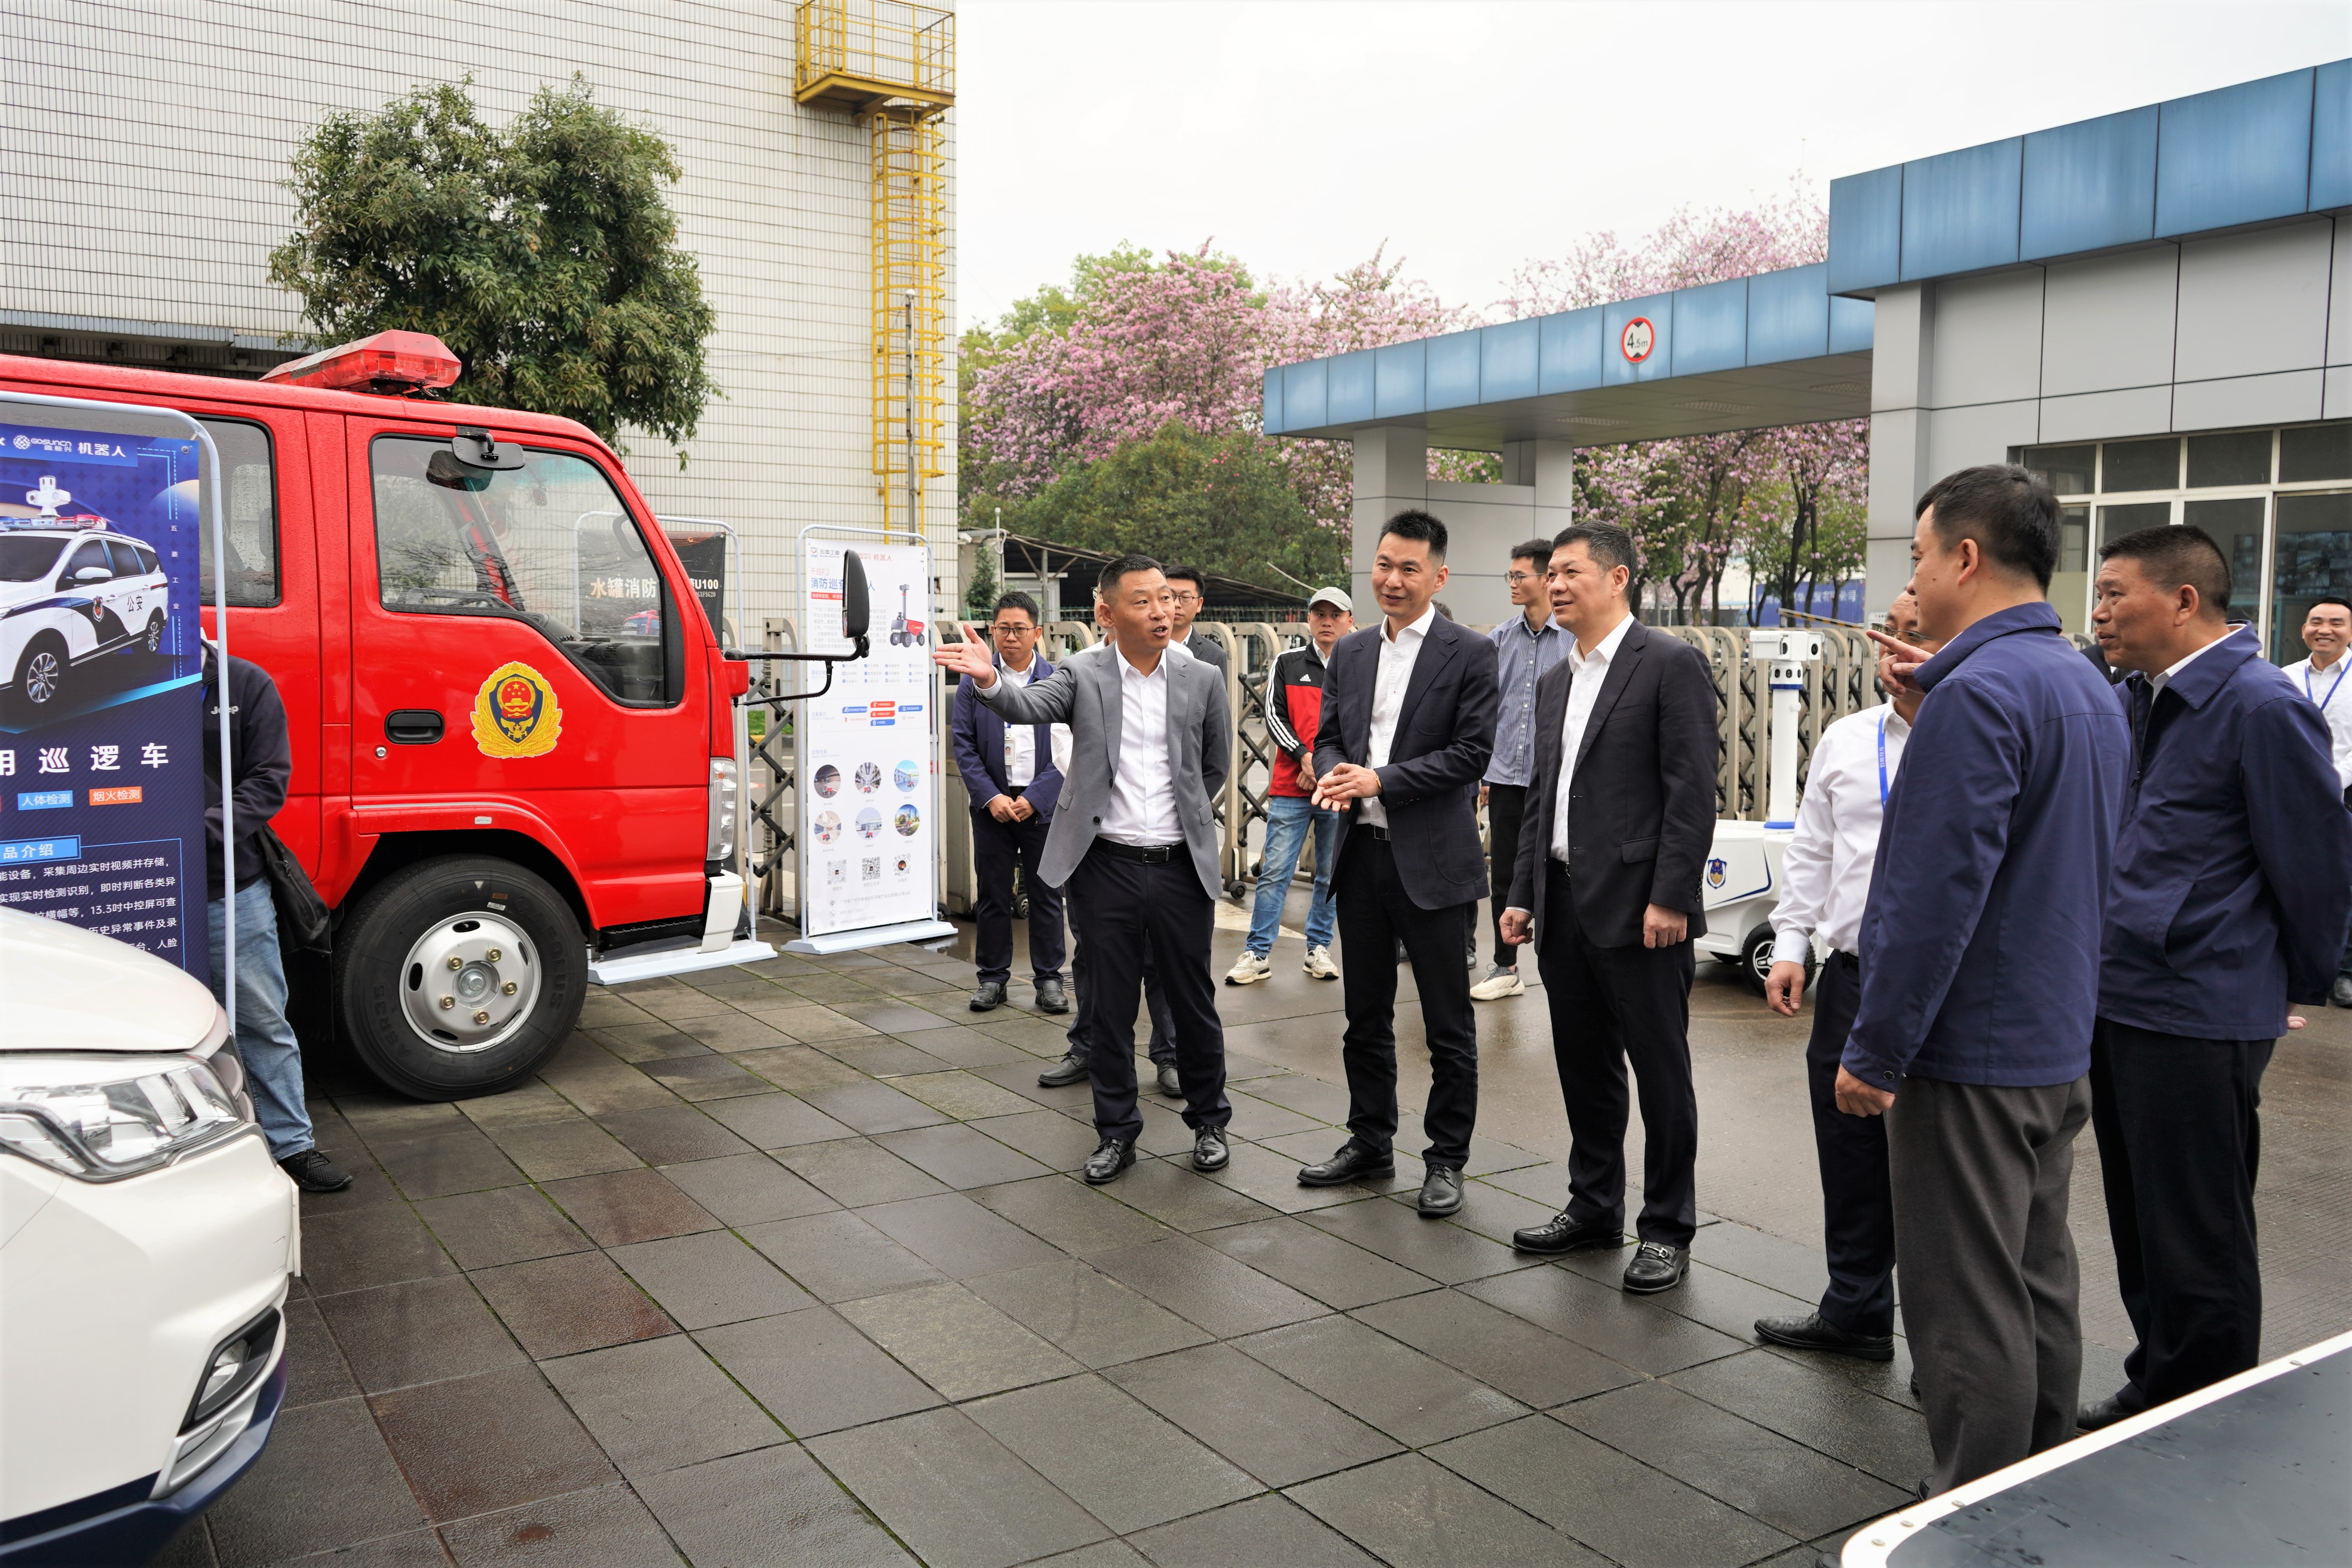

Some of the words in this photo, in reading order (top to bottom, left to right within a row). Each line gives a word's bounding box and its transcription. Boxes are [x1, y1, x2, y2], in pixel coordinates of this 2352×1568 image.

[1627, 332, 1648, 348] 4.5m
[78, 442, 126, 458] 机器人
[590, 577, 657, 598] 水罐消防
[127, 595, 143, 612] 公安
[22, 793, 71, 807] 人体检测
[93, 789, 140, 803] 烟火检测
